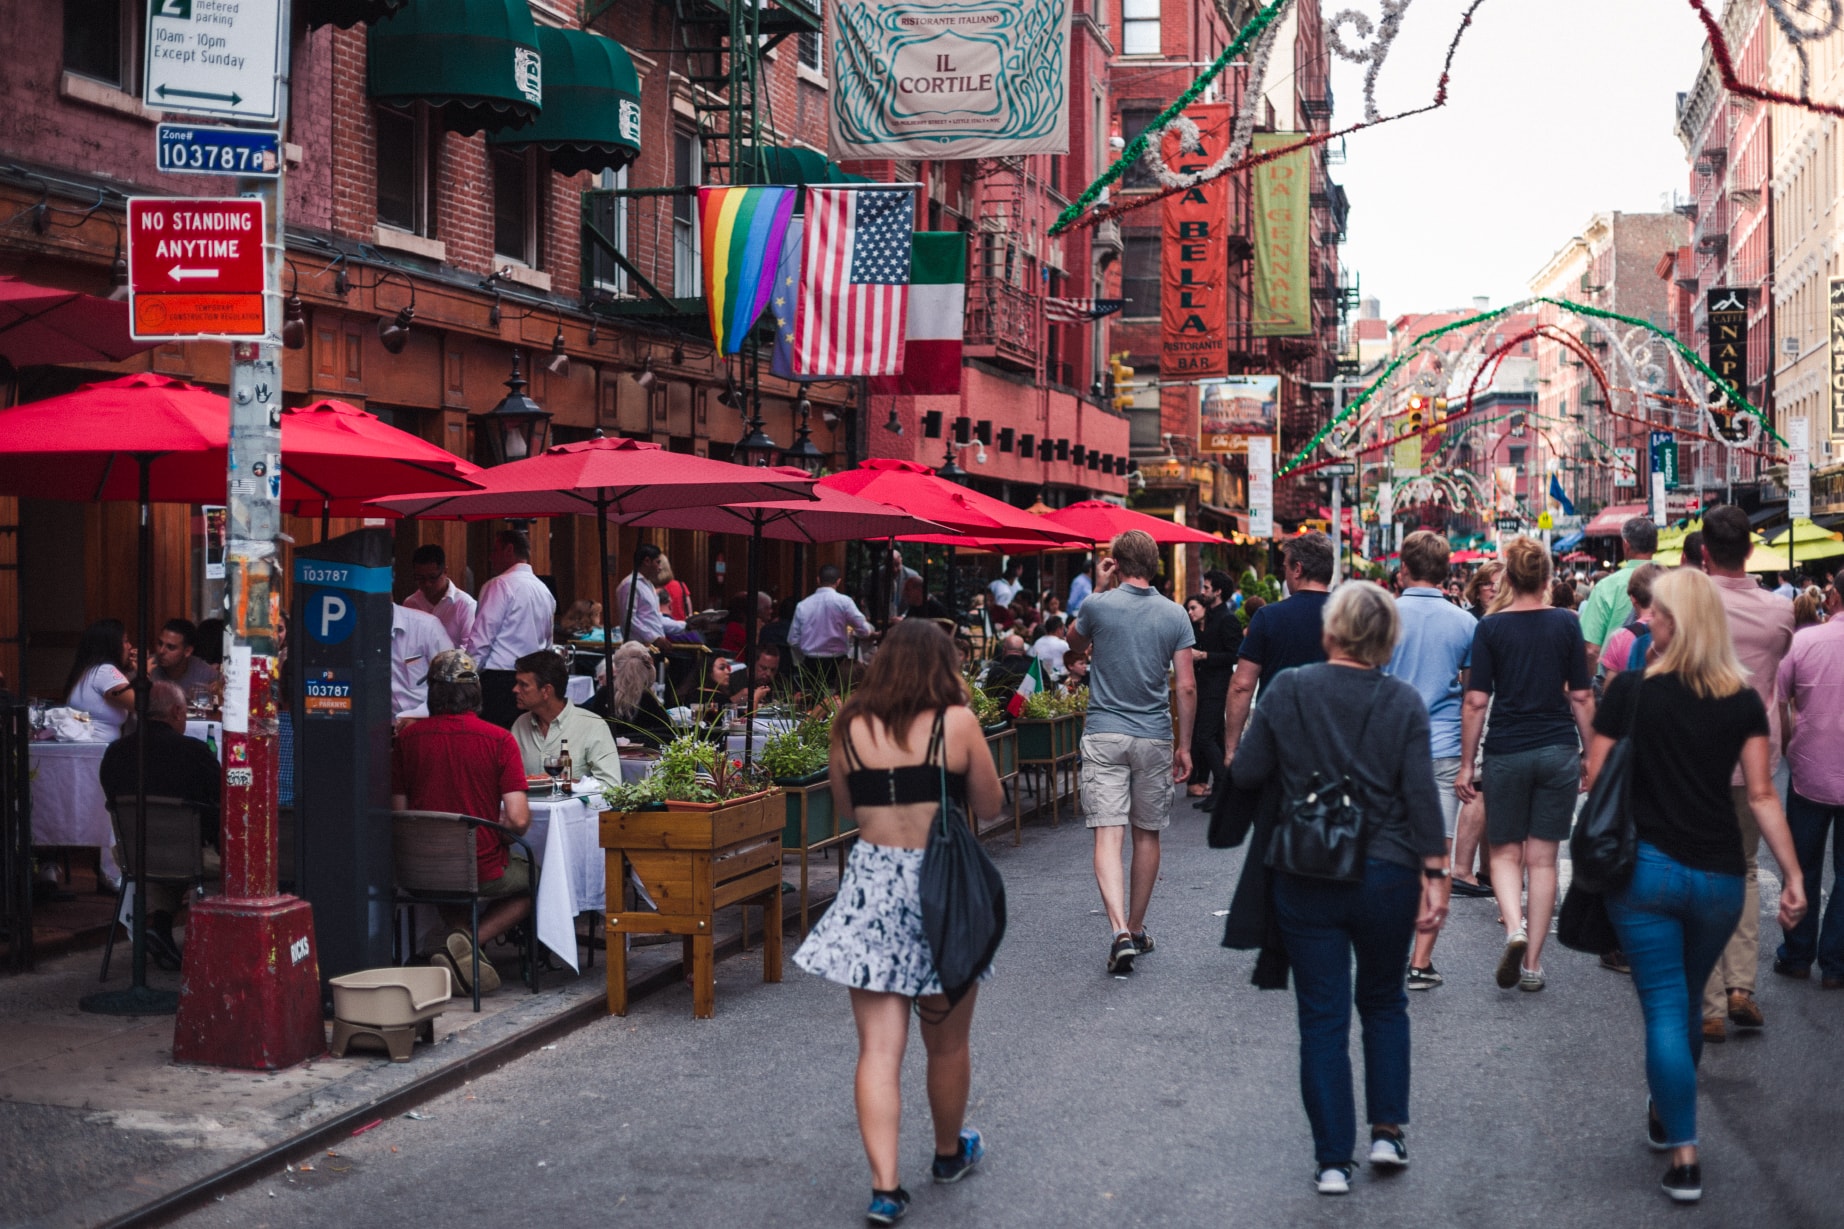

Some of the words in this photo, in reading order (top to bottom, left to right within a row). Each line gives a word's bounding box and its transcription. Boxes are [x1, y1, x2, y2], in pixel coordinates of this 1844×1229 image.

[196, 0, 239, 13] metered
[196, 13, 234, 27] parking
[901, 17, 956, 26] RISTORANTE
[958, 15, 999, 24] ITALIANO
[156, 28, 185, 44] 10am
[197, 33, 226, 48] 10pm
[154, 45, 196, 63] Except
[201, 50, 245, 70] Sunday
[936, 54, 957, 73] IL
[899, 73, 992, 94] CORTILE
[162, 129, 193, 140] Zone#
[163, 143, 250, 169] 103787
[1269, 165, 1294, 197] DA
[142, 212, 164, 231] NO
[173, 212, 252, 231] STANDING
[156, 240, 240, 258] ANYTIME
[1179, 221, 1209, 333] BELLA
[1163, 339, 1223, 351] RISTORANTE
[1178, 357, 1210, 369] BAR
[303, 570, 348, 581] 103787
[321, 595, 347, 637] P
[308, 685, 349, 697] 103787
